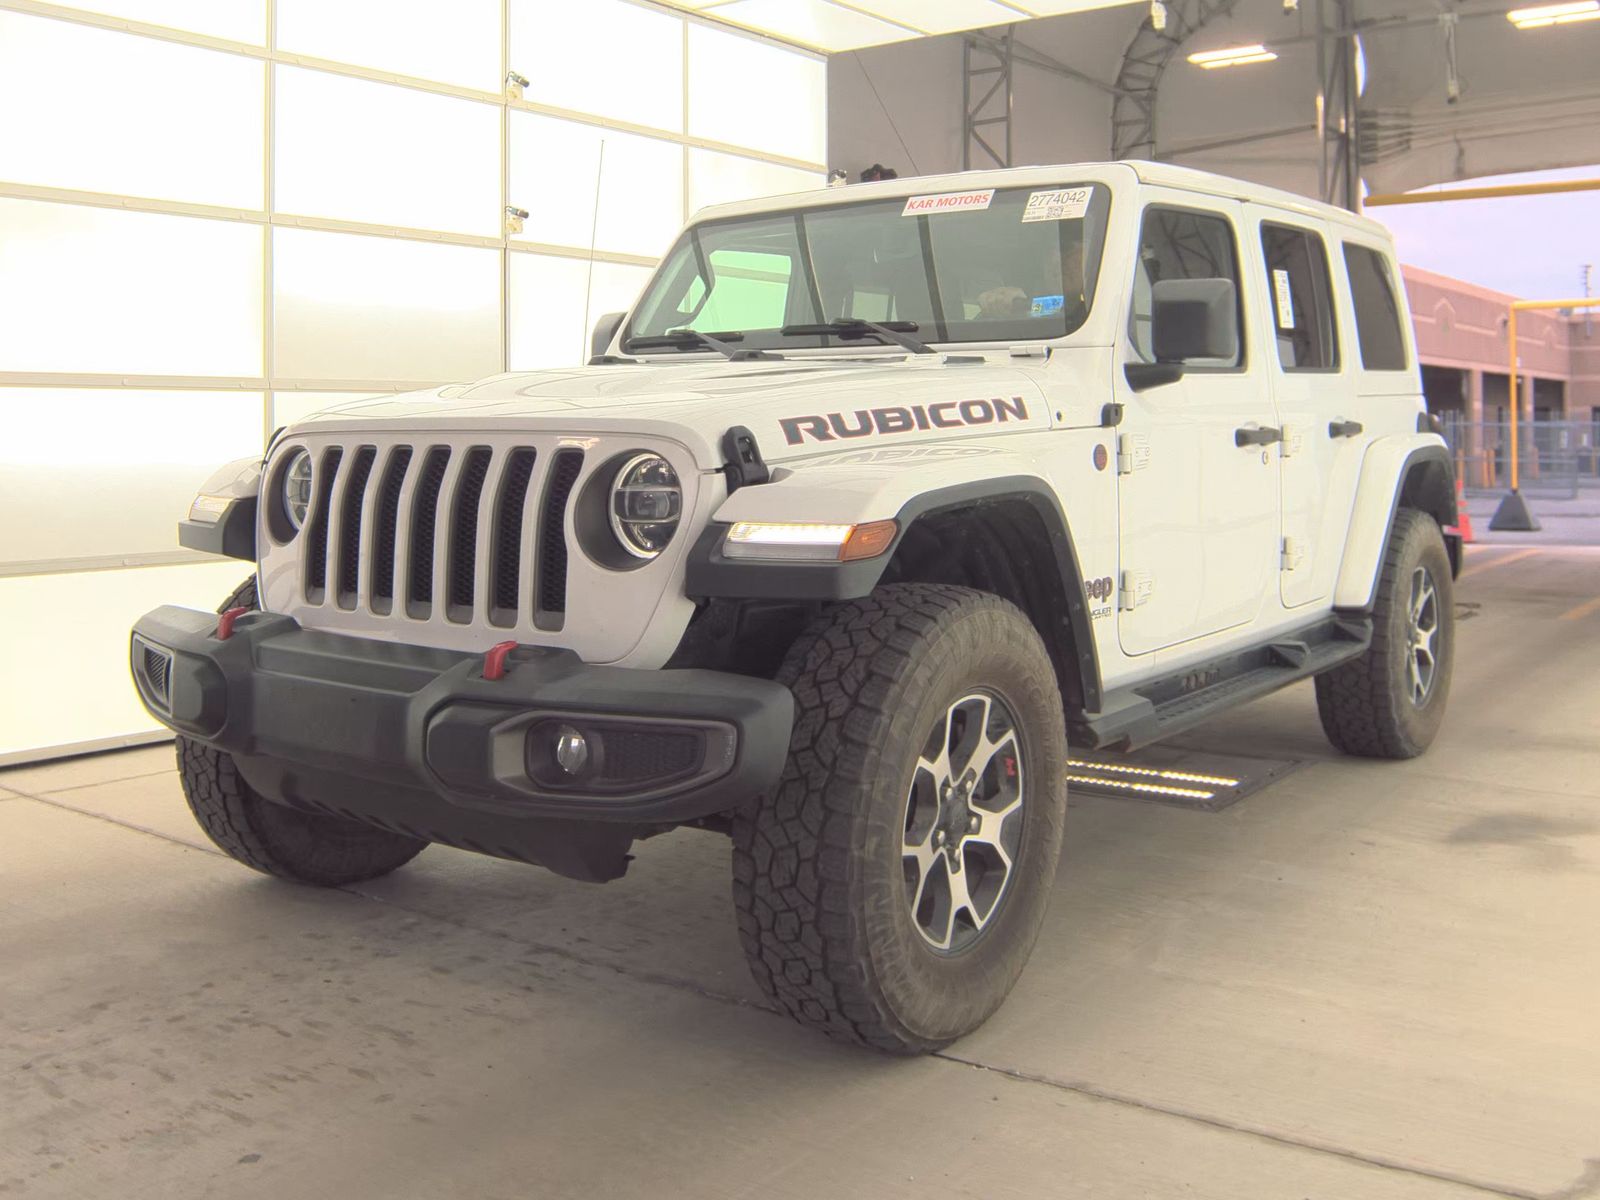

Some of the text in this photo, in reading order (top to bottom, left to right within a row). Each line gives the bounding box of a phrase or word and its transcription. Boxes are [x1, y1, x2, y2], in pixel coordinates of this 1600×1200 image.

[907, 193, 991, 210] KAR MOTORS
[1029, 190, 1087, 207] 2774042
[778, 396, 1029, 446] RUBICON
[1085, 576, 1113, 603] eep
